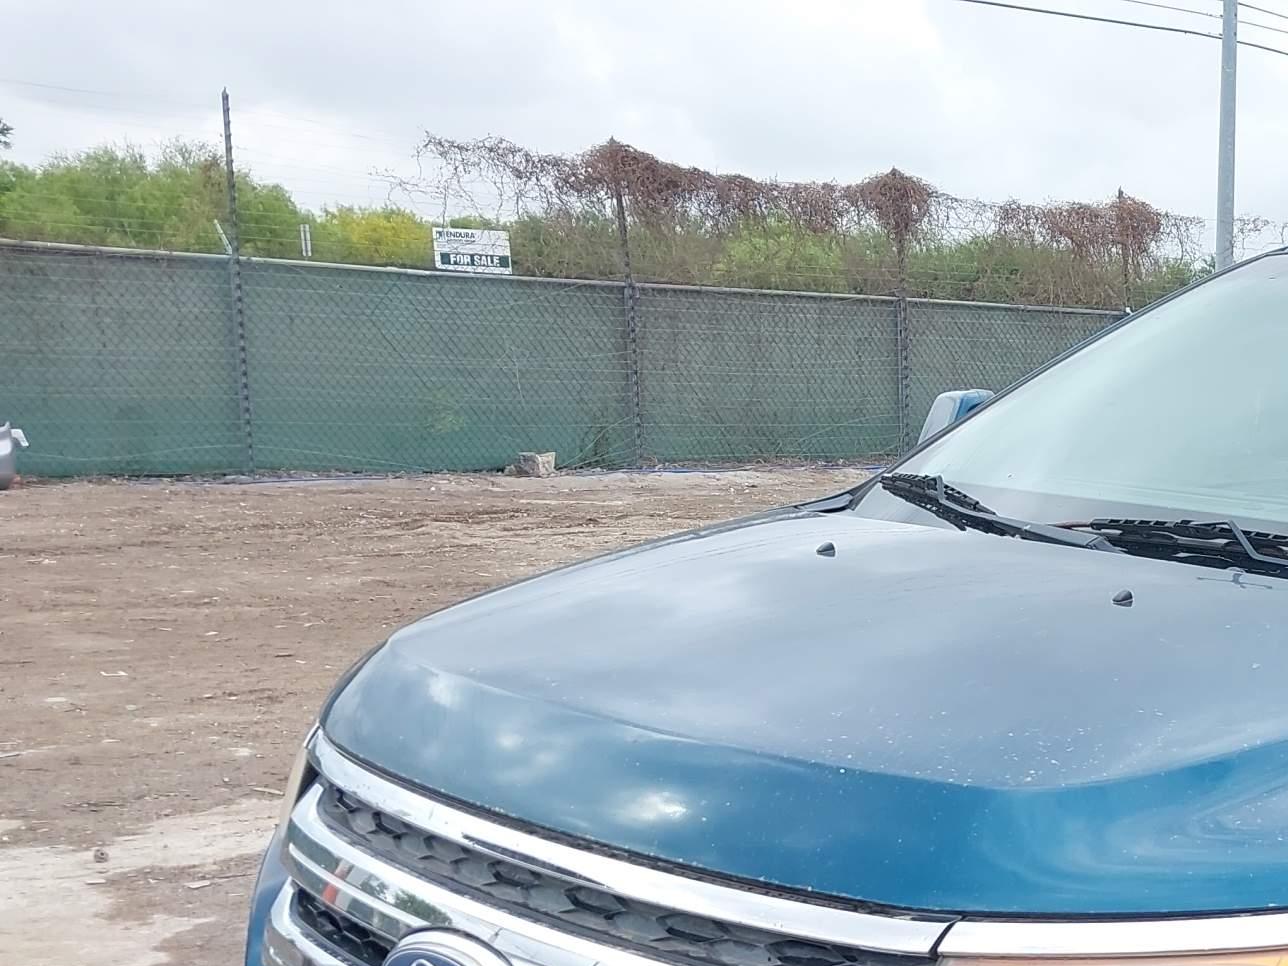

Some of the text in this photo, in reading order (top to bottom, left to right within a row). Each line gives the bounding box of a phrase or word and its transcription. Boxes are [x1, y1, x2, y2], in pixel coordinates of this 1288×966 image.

[446, 231, 475, 239] ENDURA
[449, 254, 500, 266] FOR SALE
